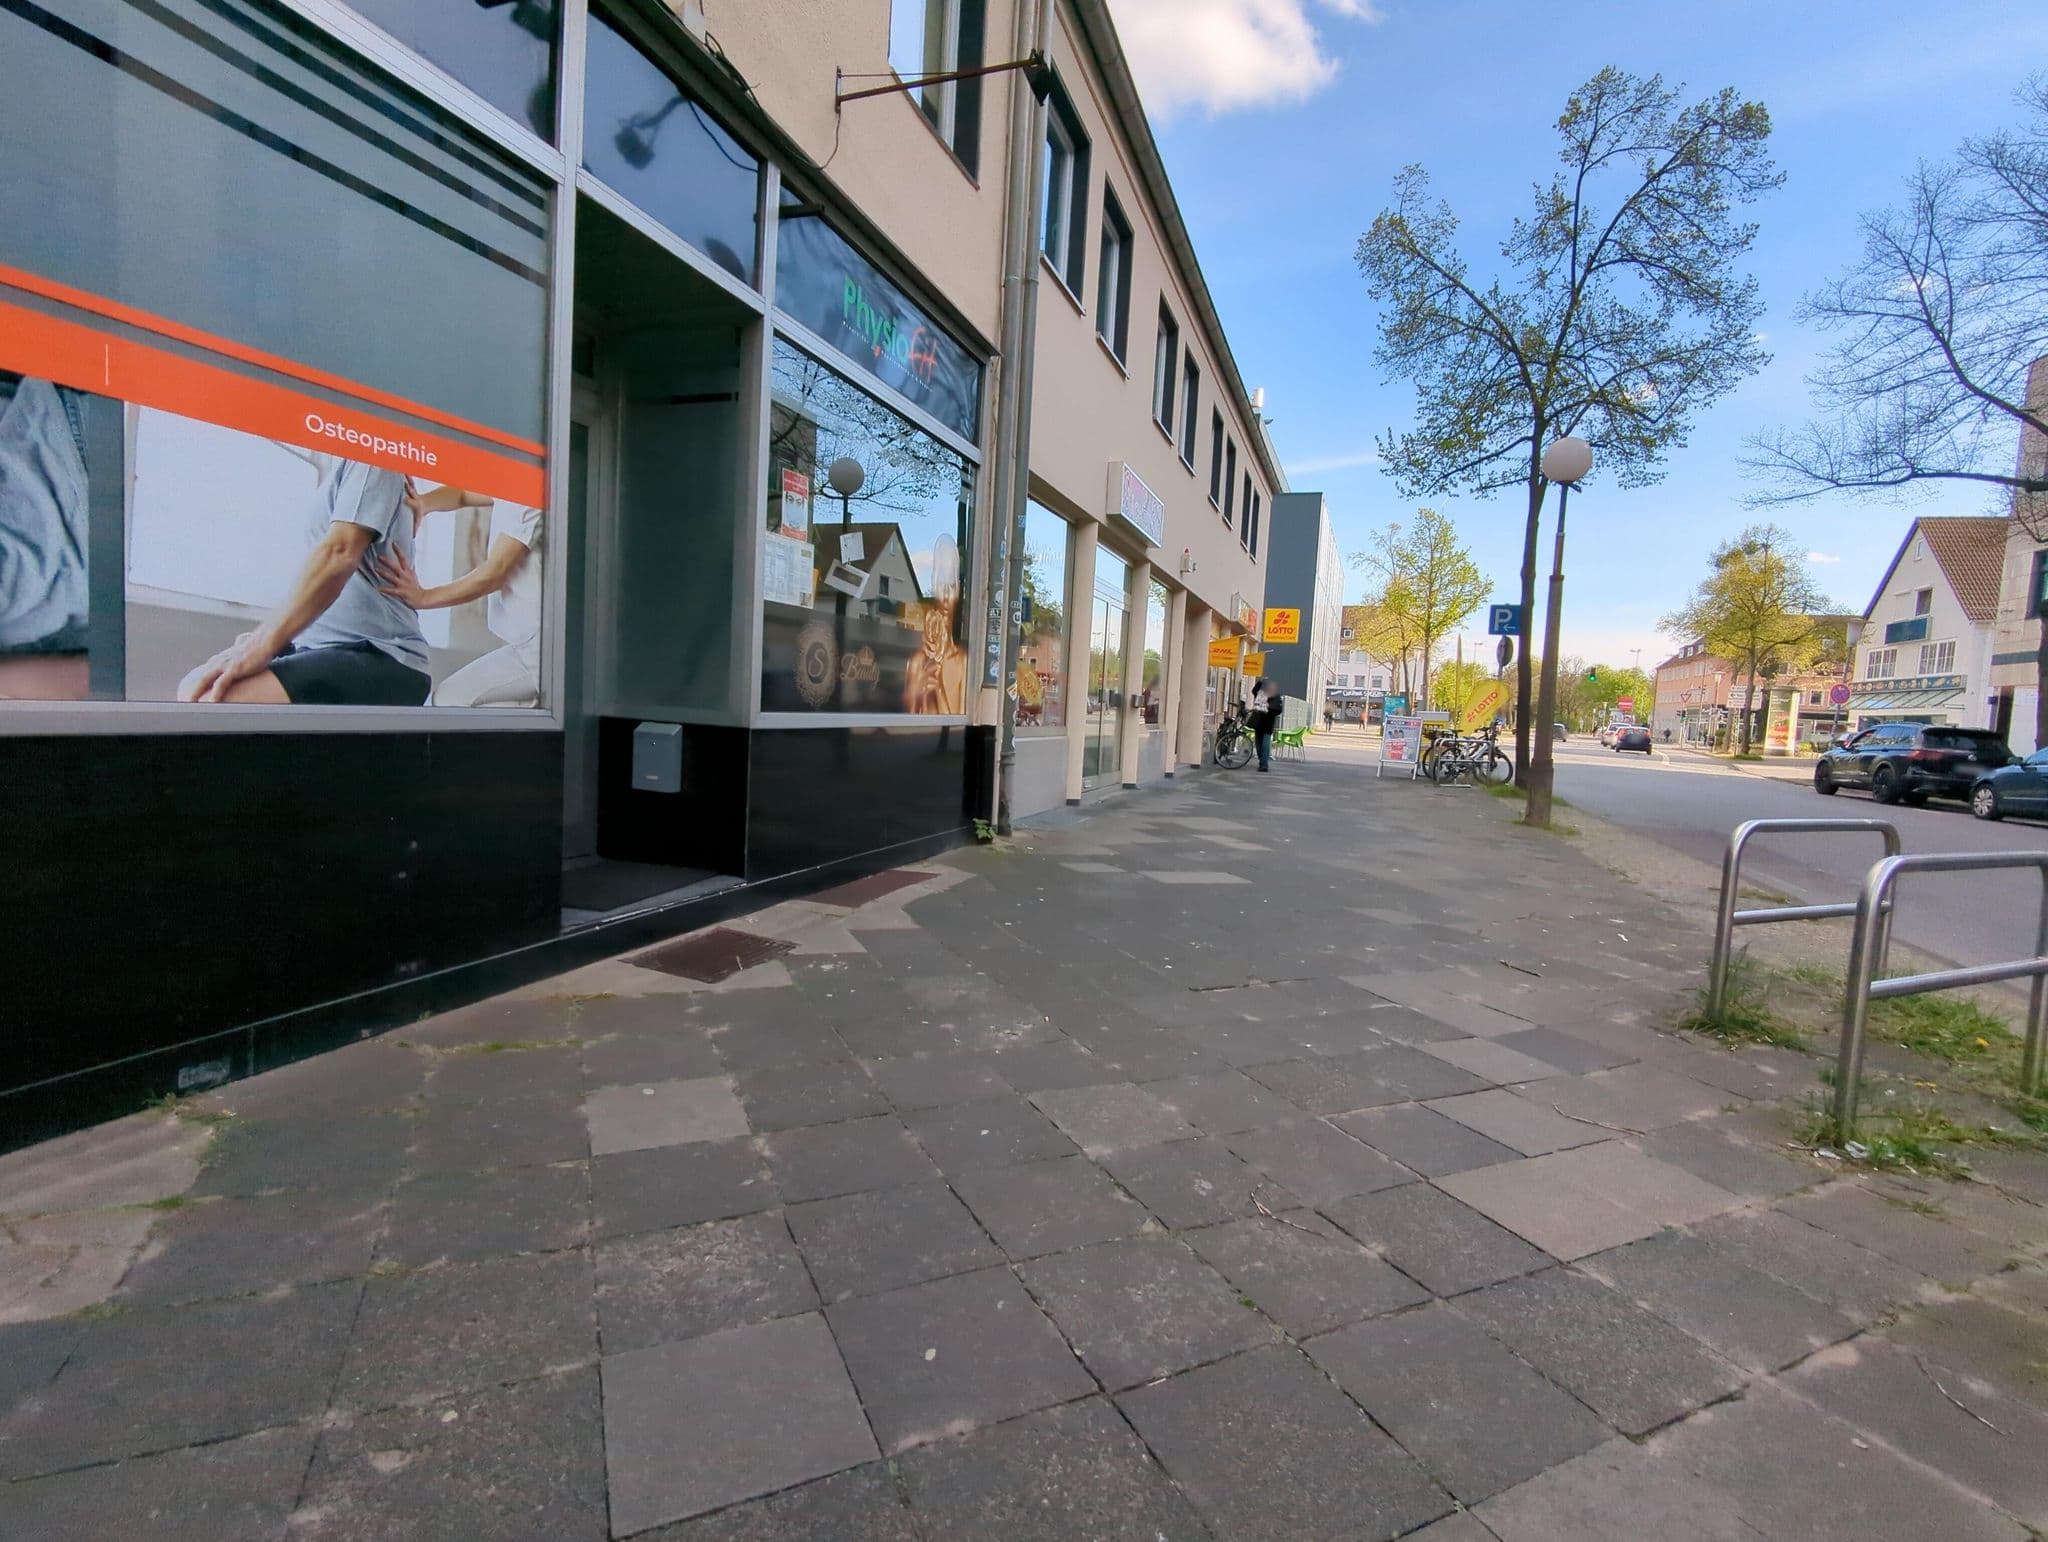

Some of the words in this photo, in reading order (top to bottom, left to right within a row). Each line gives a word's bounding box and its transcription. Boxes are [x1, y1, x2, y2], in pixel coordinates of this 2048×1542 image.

[305, 414, 438, 466] Osteopathie
[1268, 626, 1294, 634] LOTTO
[1494, 608, 1513, 632] P
[1213, 647, 1233, 655] DHL
[840, 653, 880, 689] Beauty
[1474, 691, 1498, 714] LOTTO
